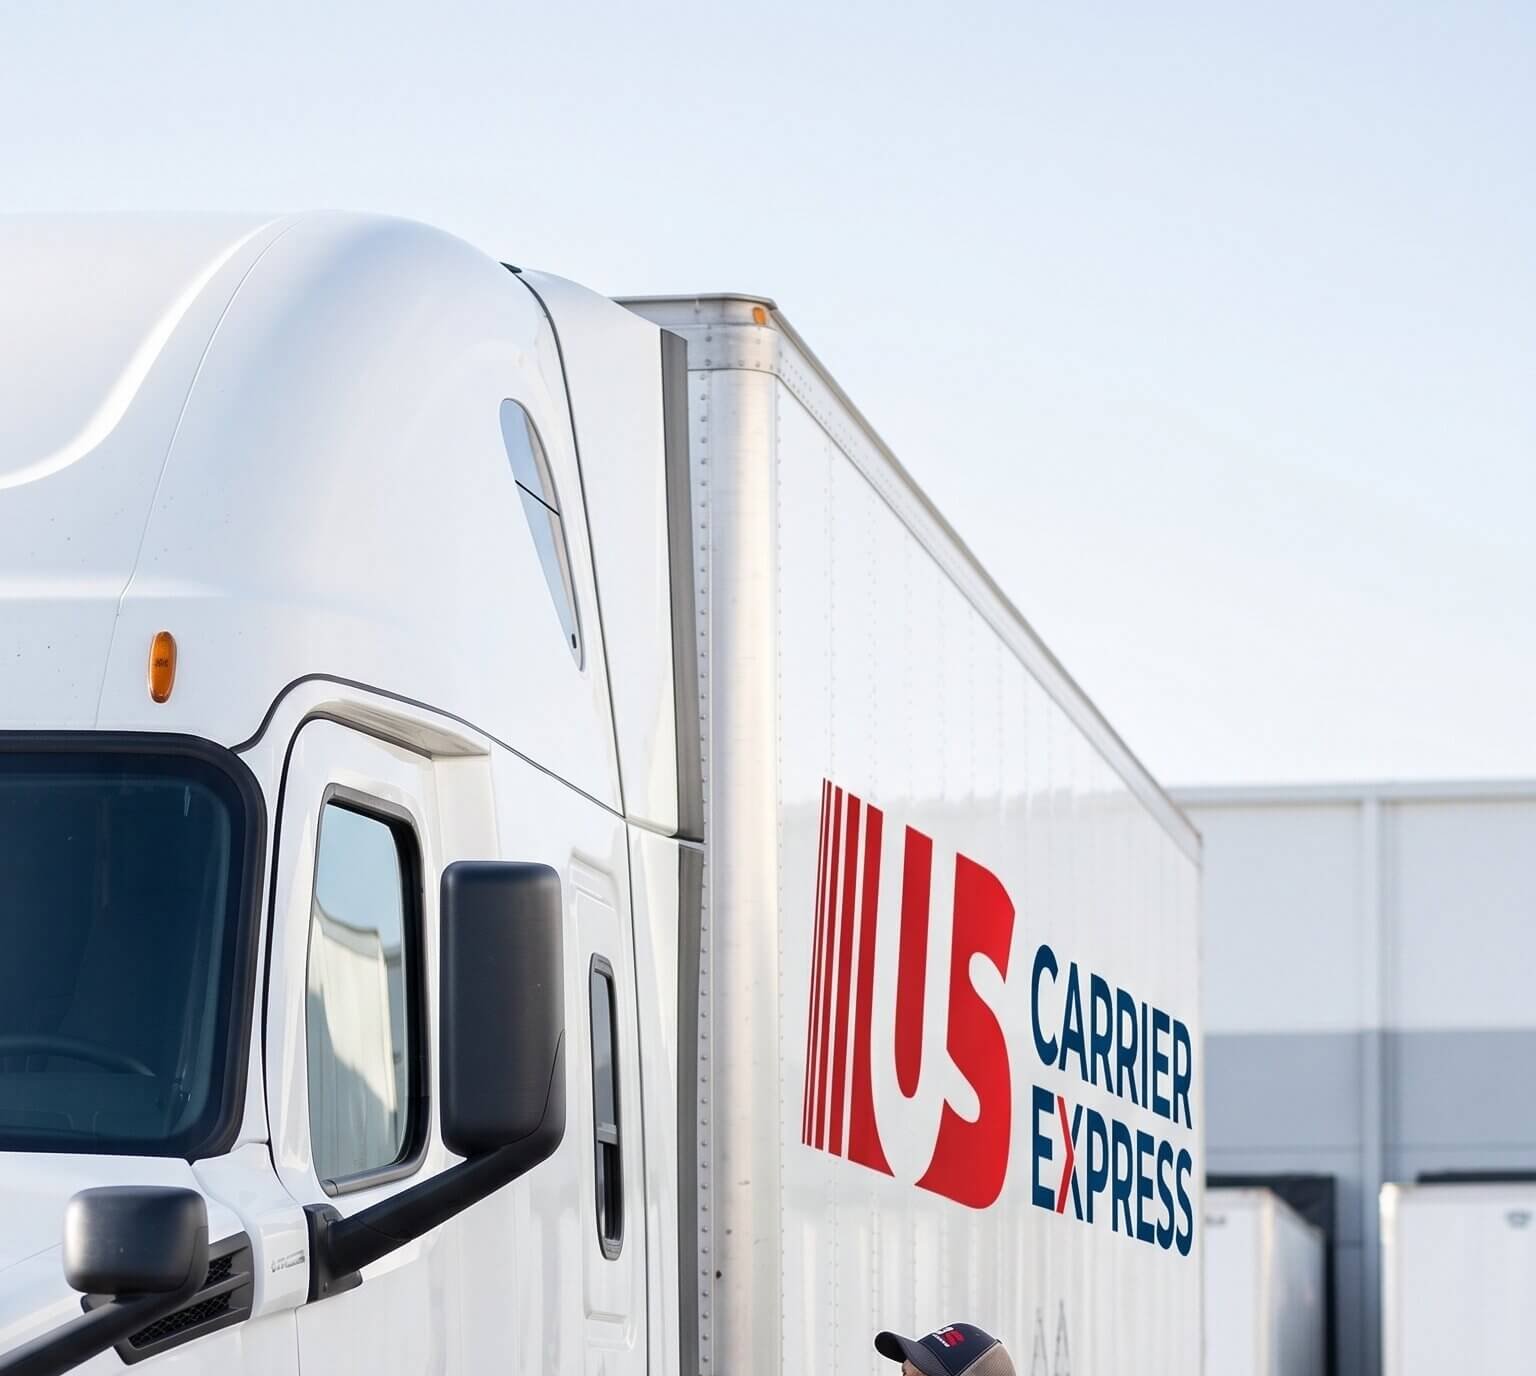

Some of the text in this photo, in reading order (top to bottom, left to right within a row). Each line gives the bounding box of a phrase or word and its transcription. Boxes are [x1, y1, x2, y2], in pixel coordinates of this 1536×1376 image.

[802, 778, 1016, 1209] US
[1031, 944, 1193, 1129] CARRIER
[1031, 1084, 1193, 1257] EXPRESS
